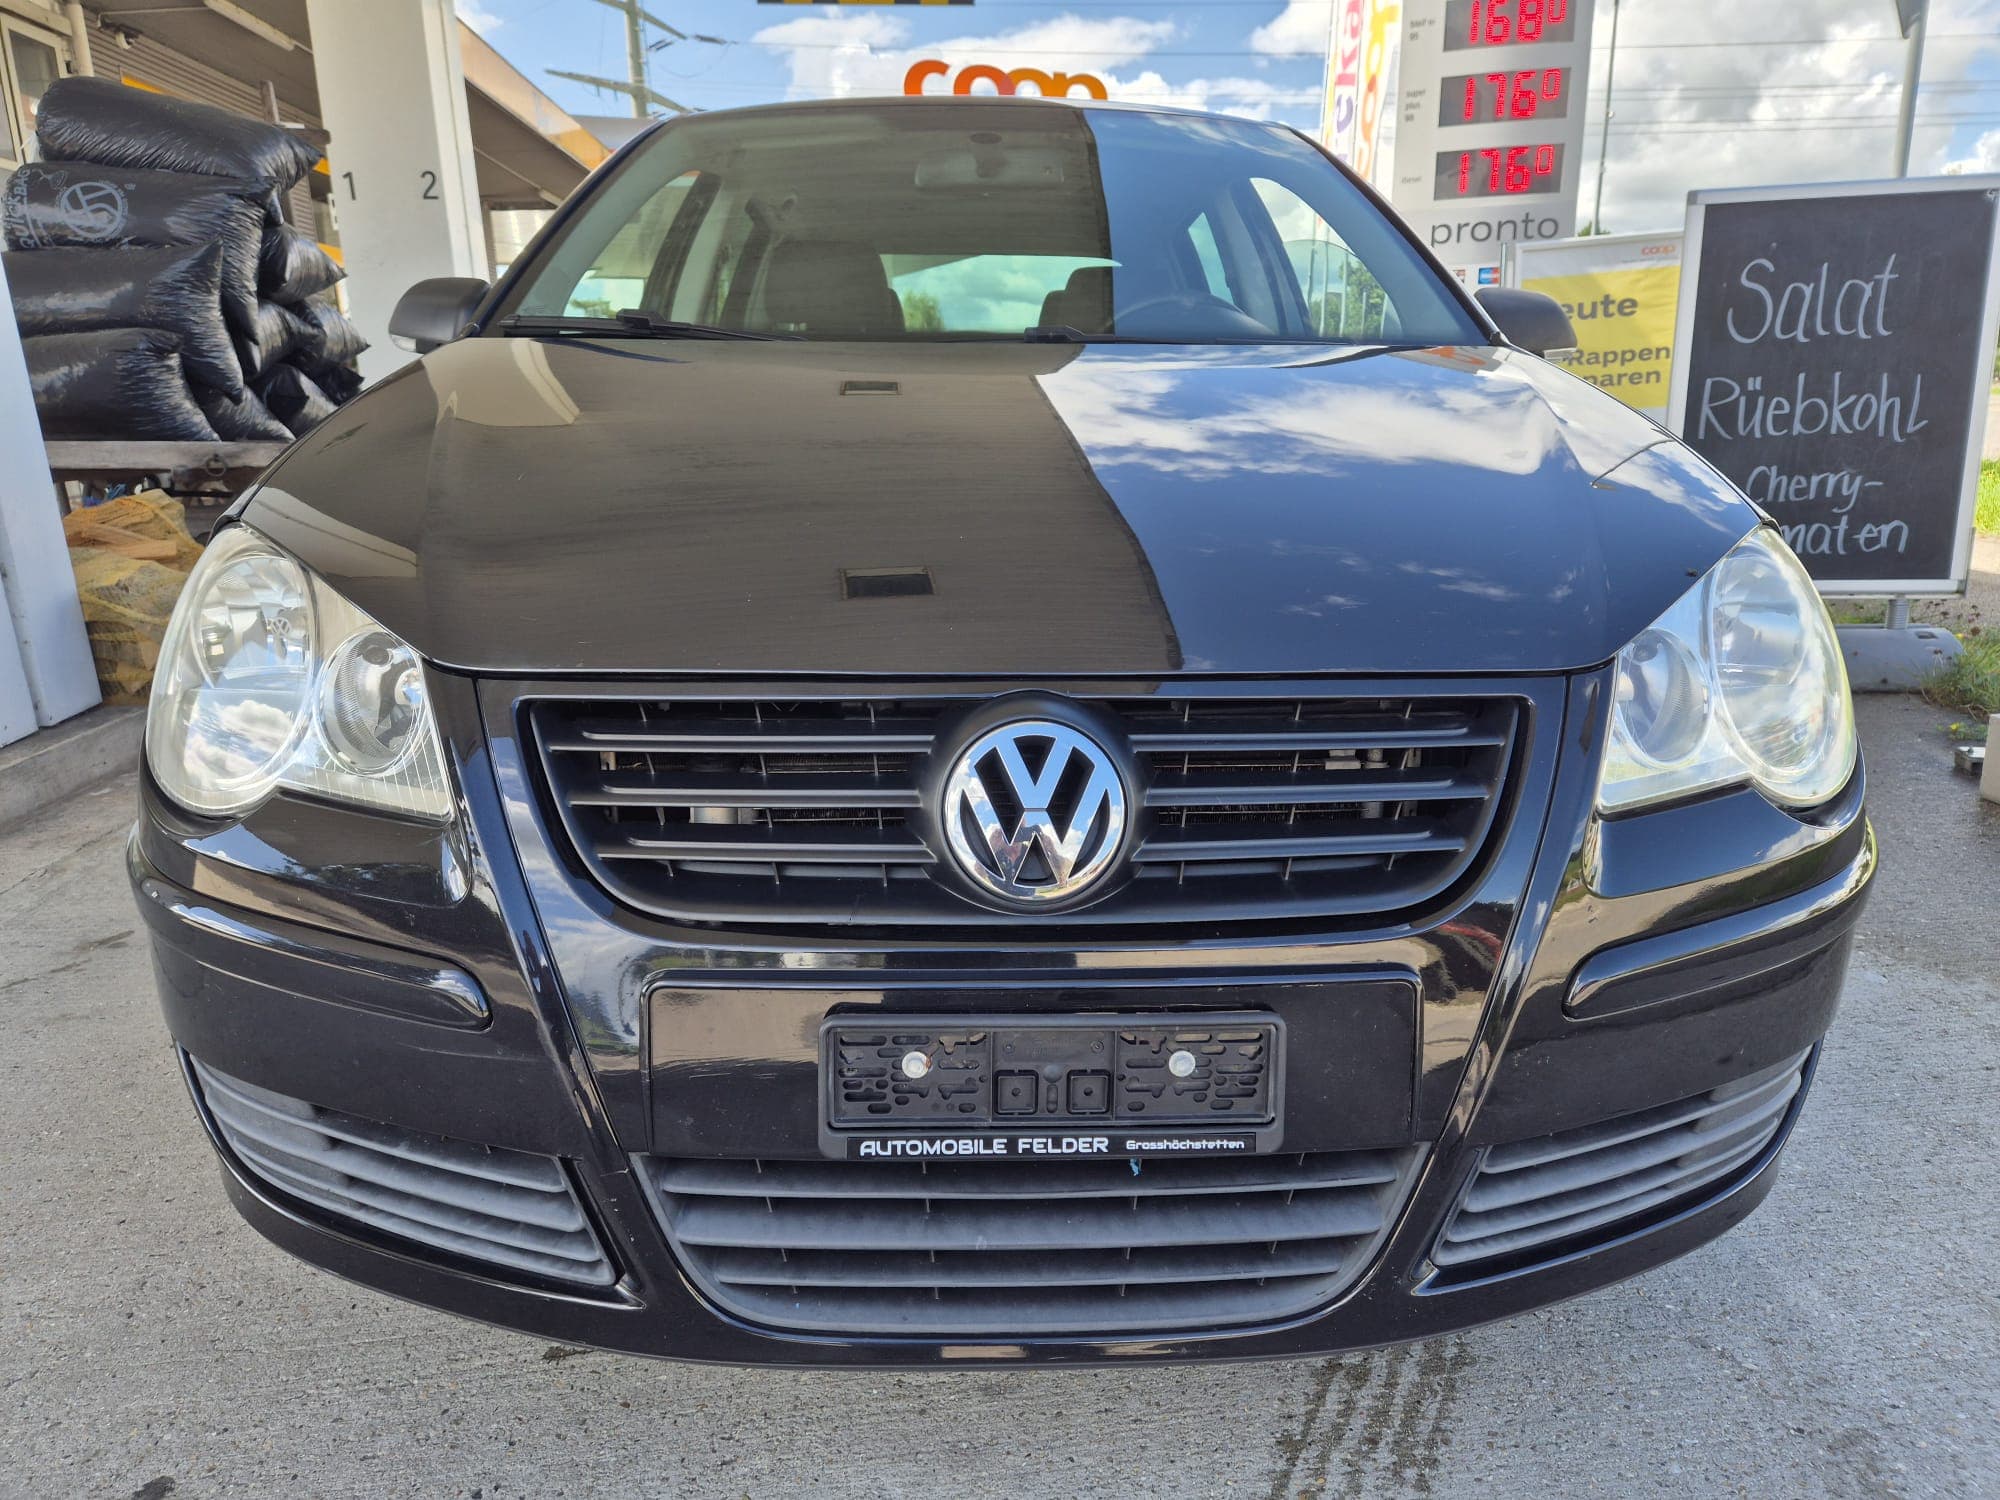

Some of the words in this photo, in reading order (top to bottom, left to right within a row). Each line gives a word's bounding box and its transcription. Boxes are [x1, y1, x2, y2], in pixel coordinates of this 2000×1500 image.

[343, 172, 357, 200] 1
[420, 171, 440, 200] 2
[1430, 212, 1559, 247] pronto
[1562, 294, 1639, 320] eute
[1727, 254, 1899, 344] Salat
[1567, 346, 1671, 367] Rappen
[1697, 371, 1929, 442] Rüebkohl
[1746, 465, 1884, 513] Cherry-
[860, 1138, 1008, 1156] AUTOMOBILE
[1018, 1137, 1109, 1154] FELDER
[1126, 1139, 1245, 1150] Grosshöchstetten
